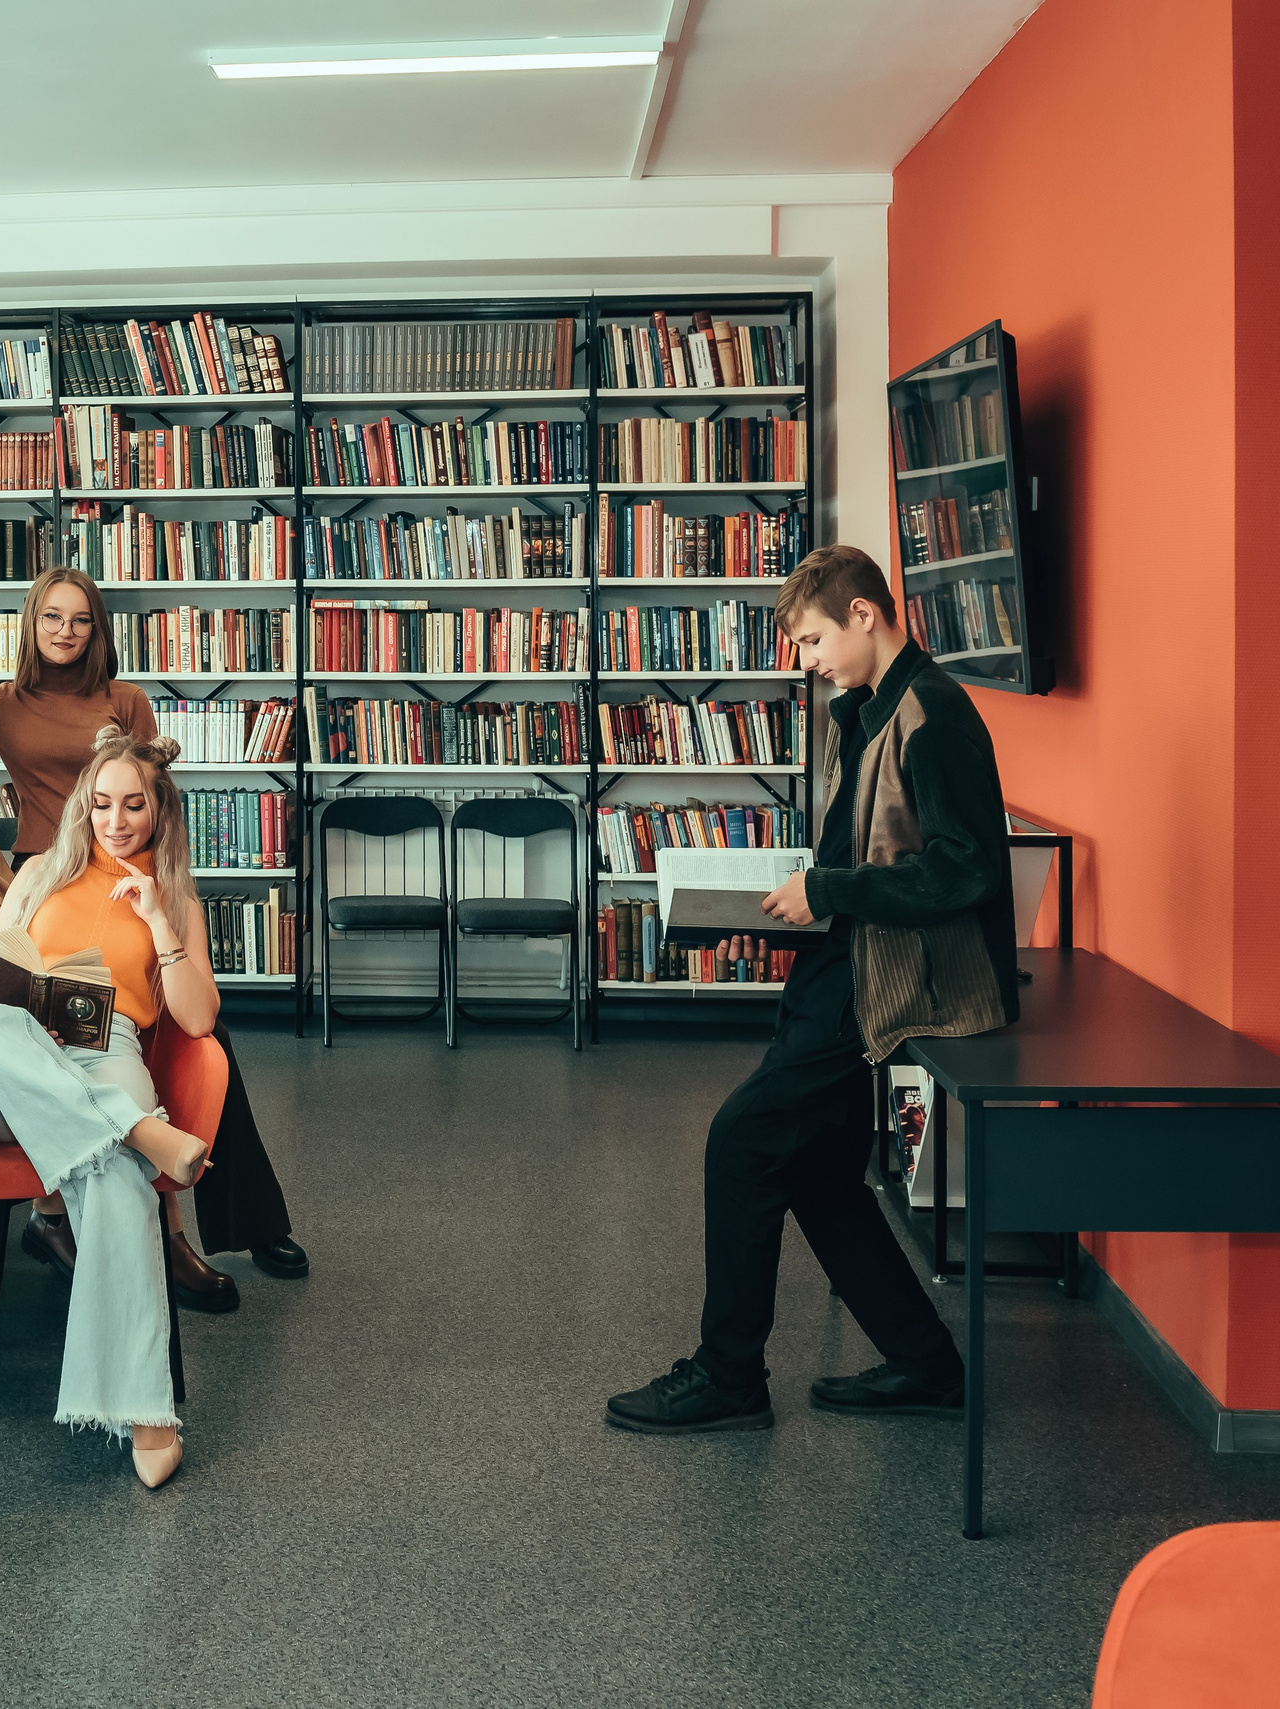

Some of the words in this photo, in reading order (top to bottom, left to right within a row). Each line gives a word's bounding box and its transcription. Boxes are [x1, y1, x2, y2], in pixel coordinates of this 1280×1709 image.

[111, 416, 119, 447] РОДИНЫ
[114, 475, 121, 486] НА
[180, 607, 190, 632] КНИГА
[180, 642, 190, 670] ЧЕРНАЯ
